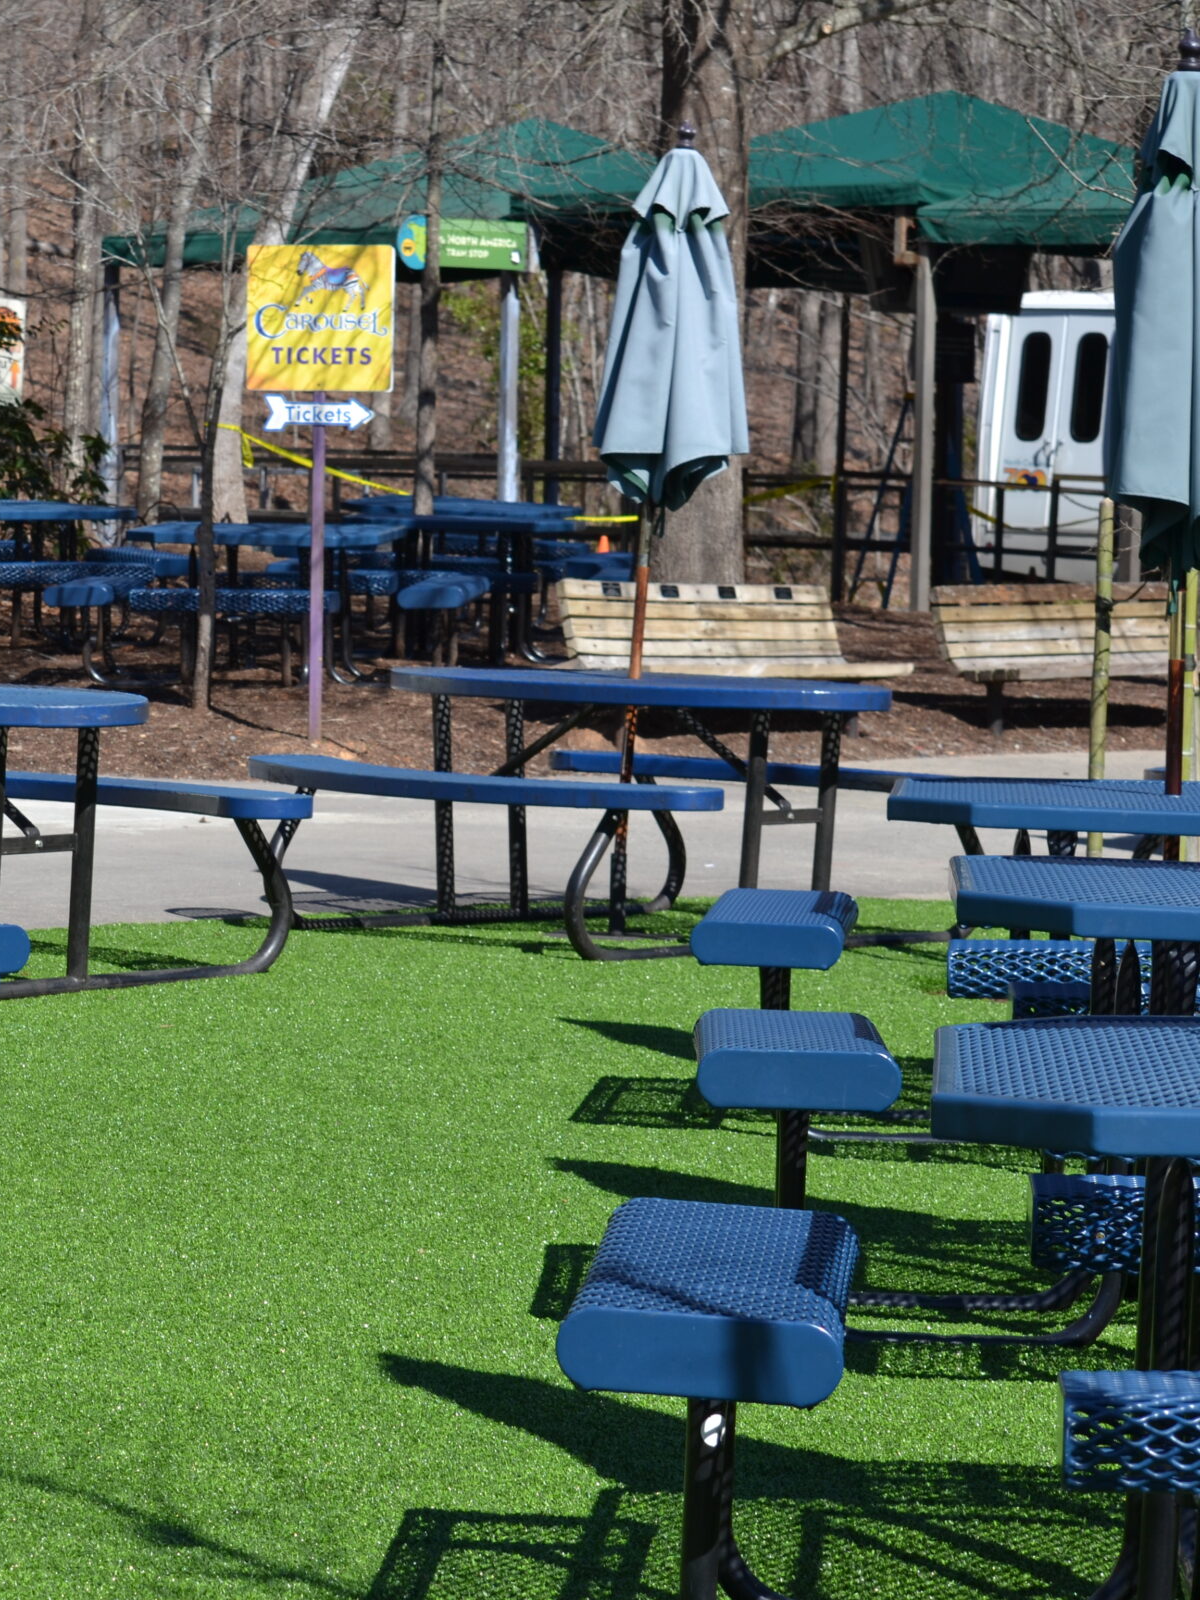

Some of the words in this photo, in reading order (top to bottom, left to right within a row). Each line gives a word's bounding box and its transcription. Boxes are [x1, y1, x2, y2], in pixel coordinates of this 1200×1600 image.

[468, 249, 490, 259] STOP
[271, 346, 373, 365] TICKETS
[285, 405, 352, 422] Tickets
